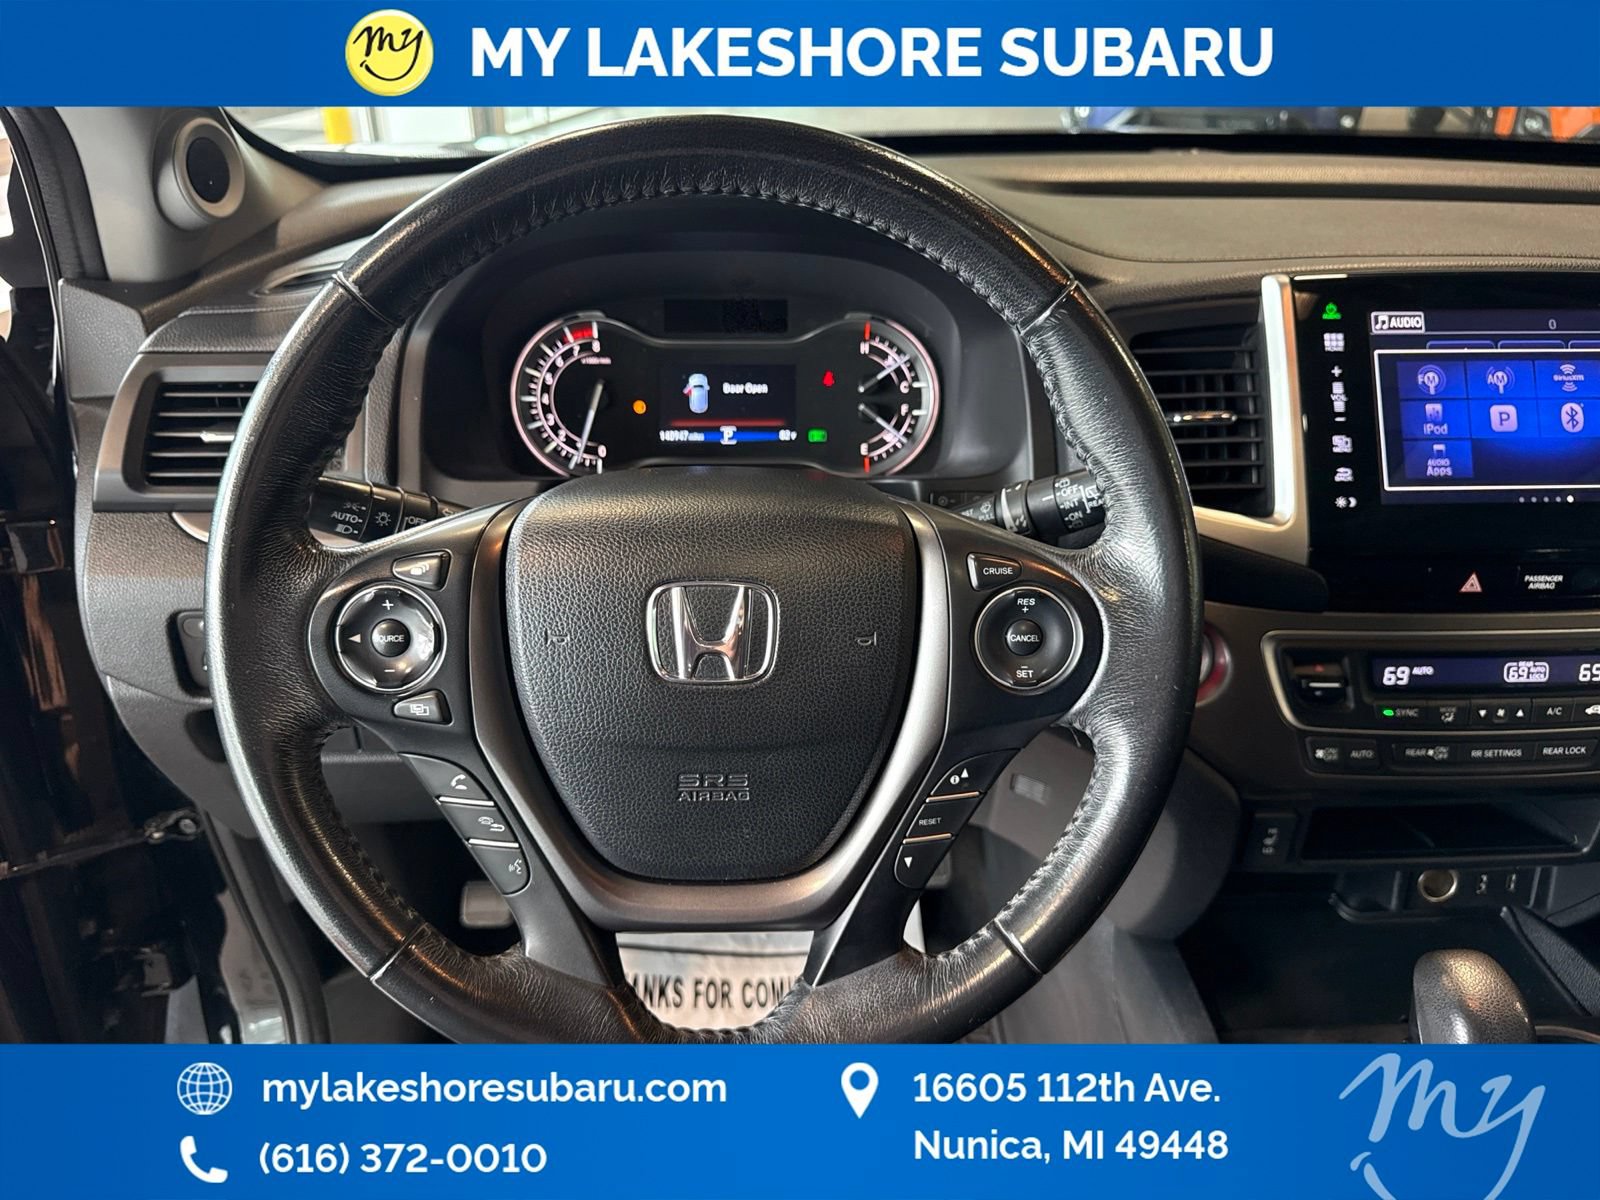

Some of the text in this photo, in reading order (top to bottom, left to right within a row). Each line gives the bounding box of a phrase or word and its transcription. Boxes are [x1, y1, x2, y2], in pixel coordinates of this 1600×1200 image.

[1390, 317, 1422, 329] AUDIO
[592, 340, 601, 353] 8
[723, 382, 768, 395] Door Open
[1424, 423, 1448, 435] iPod
[598, 445, 607, 458] 0
[1427, 467, 1453, 478] Apps
[1061, 484, 1078, 497] OFF
[331, 511, 359, 524] AUTO
[1069, 511, 1084, 521] ON
[983, 567, 1013, 575] CRUISE
[1528, 582, 1556, 590] AIRBAG
[1017, 598, 1036, 606] RES
[1016, 670, 1034, 678] SET
[1382, 666, 1434, 686] 69 AUTO
[1509, 666, 1528, 680] 69
[1396, 708, 1419, 717] SYNC
[1546, 707, 1562, 716] A/C
[1350, 750, 1374, 758] AUTO
[1405, 748, 1427, 756] REAR
[1471, 749, 1522, 758] RR SETTINGS
[1543, 746, 1586, 755] REAR LOCK
[678, 774, 748, 787] SRS
[678, 791, 750, 802] AIRBAG
[694, 977, 731, 1009] FOR
